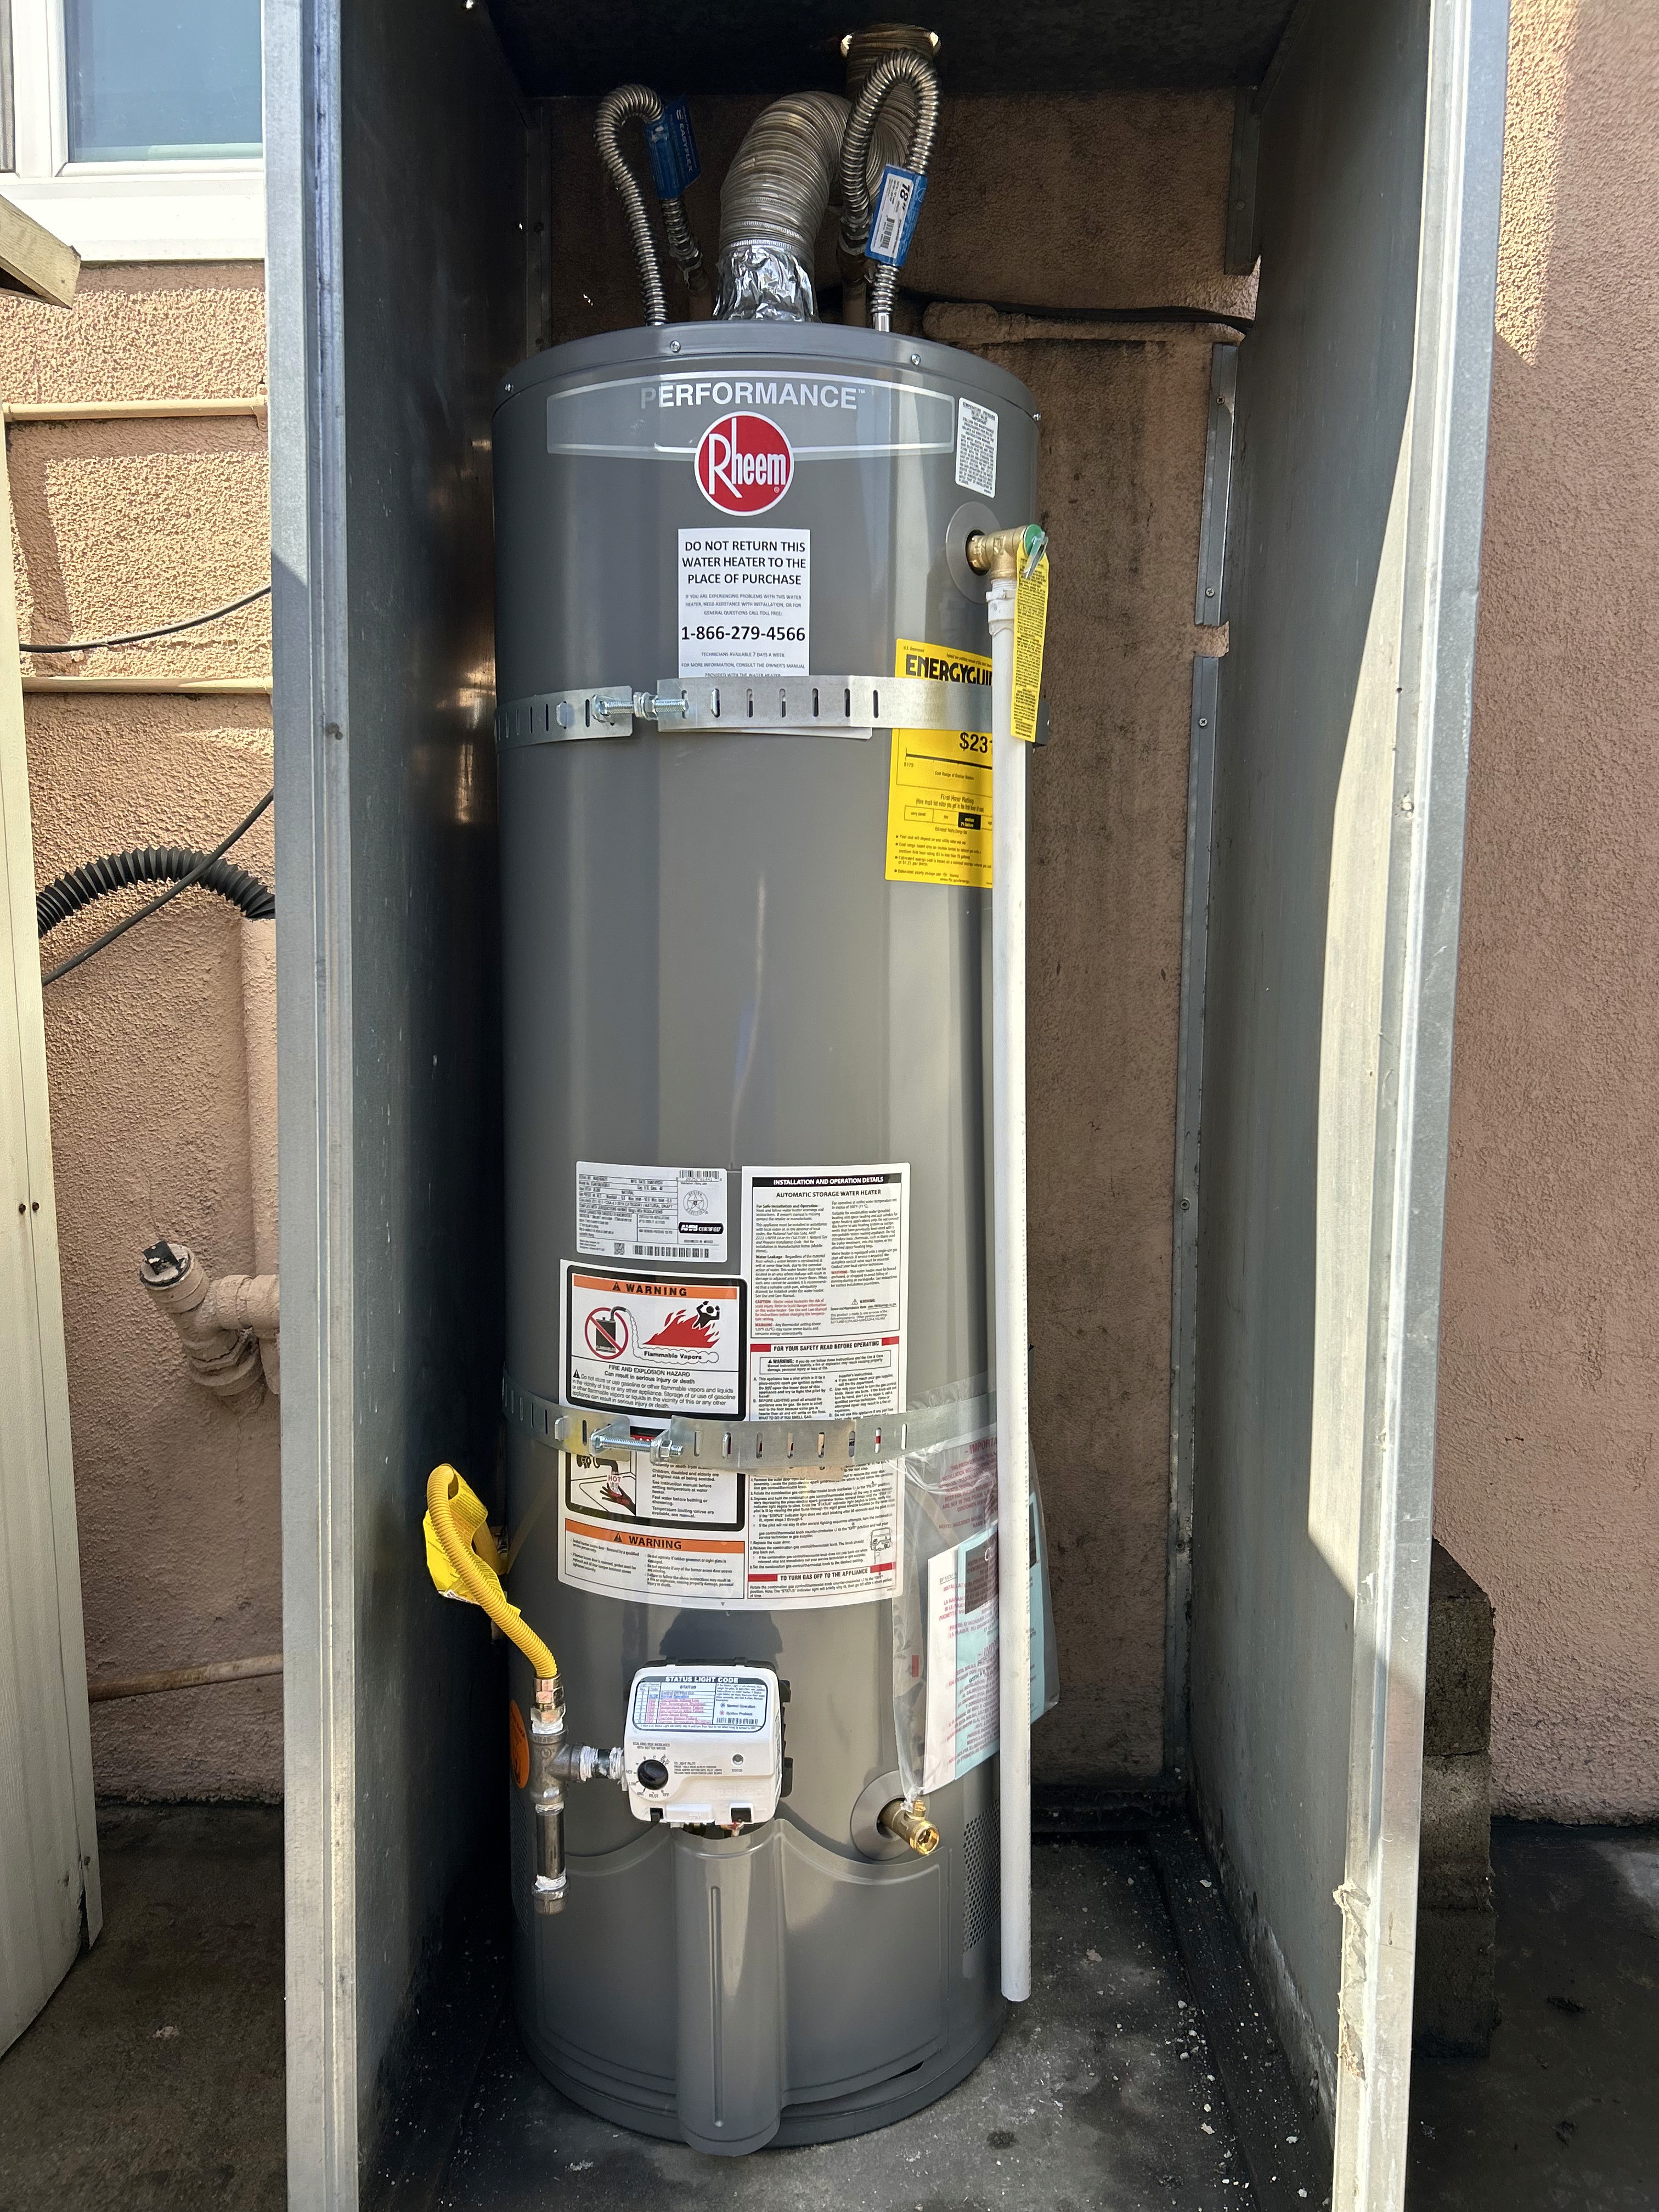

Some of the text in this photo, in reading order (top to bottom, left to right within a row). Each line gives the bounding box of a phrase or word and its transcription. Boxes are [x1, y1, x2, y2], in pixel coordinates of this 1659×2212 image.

[709, 417, 786, 498] Rheem
[685, 541, 805, 552] DO NOT RETURN THIS
[682, 557, 806, 568] WATER HEATER TO THE
[688, 574, 801, 585] PLACE OF PURCHASE
[682, 626, 805, 641] 1-866-279-4566
[960, 732, 992, 754] $23
[626, 1284, 687, 1296] WARNING
[970, 1437, 997, 1454] IMPORTA
[629, 1536, 682, 1550] WARNING
[842, 1568, 868, 1577] APPLIANCE
